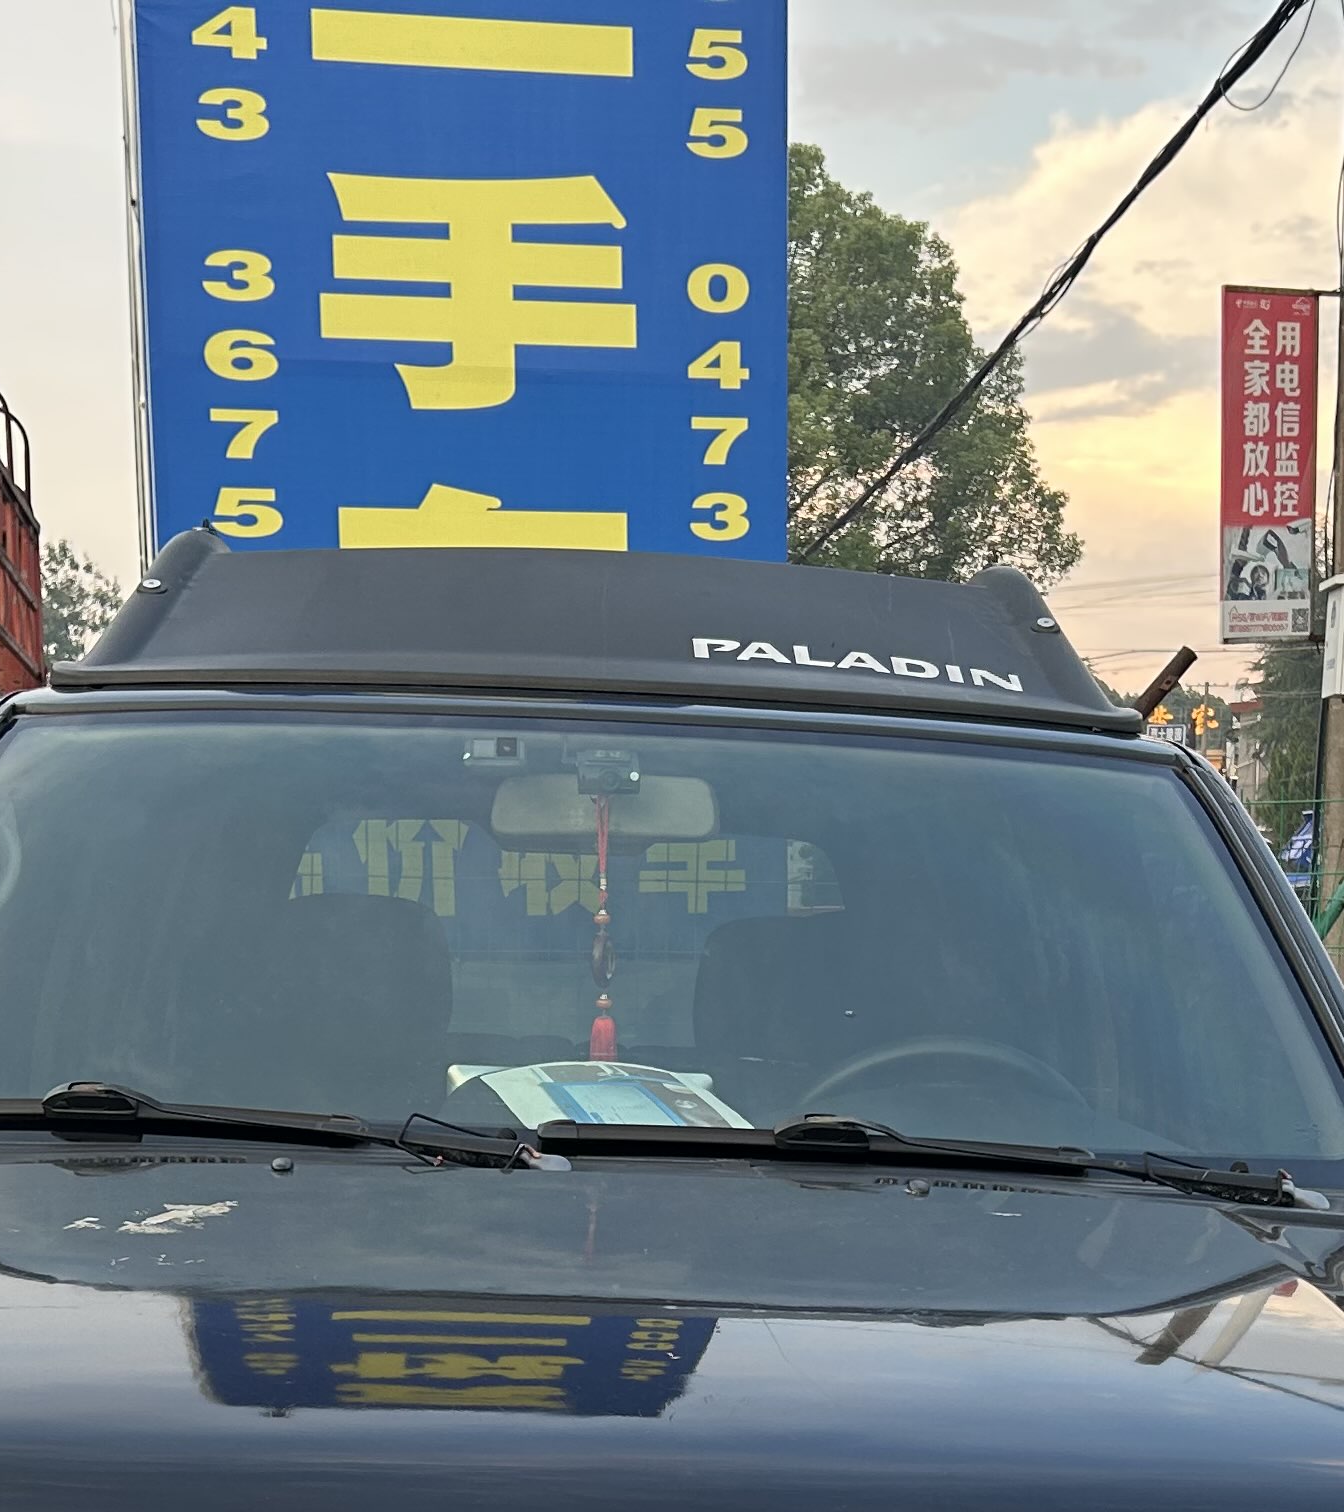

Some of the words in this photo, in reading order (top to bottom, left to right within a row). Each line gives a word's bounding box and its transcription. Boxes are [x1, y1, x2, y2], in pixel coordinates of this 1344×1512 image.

[1241, 318, 1271, 517] 全家都放心
[1274, 320, 1302, 517] 用电信监控
[692, 637, 1024, 692] PALADIN
